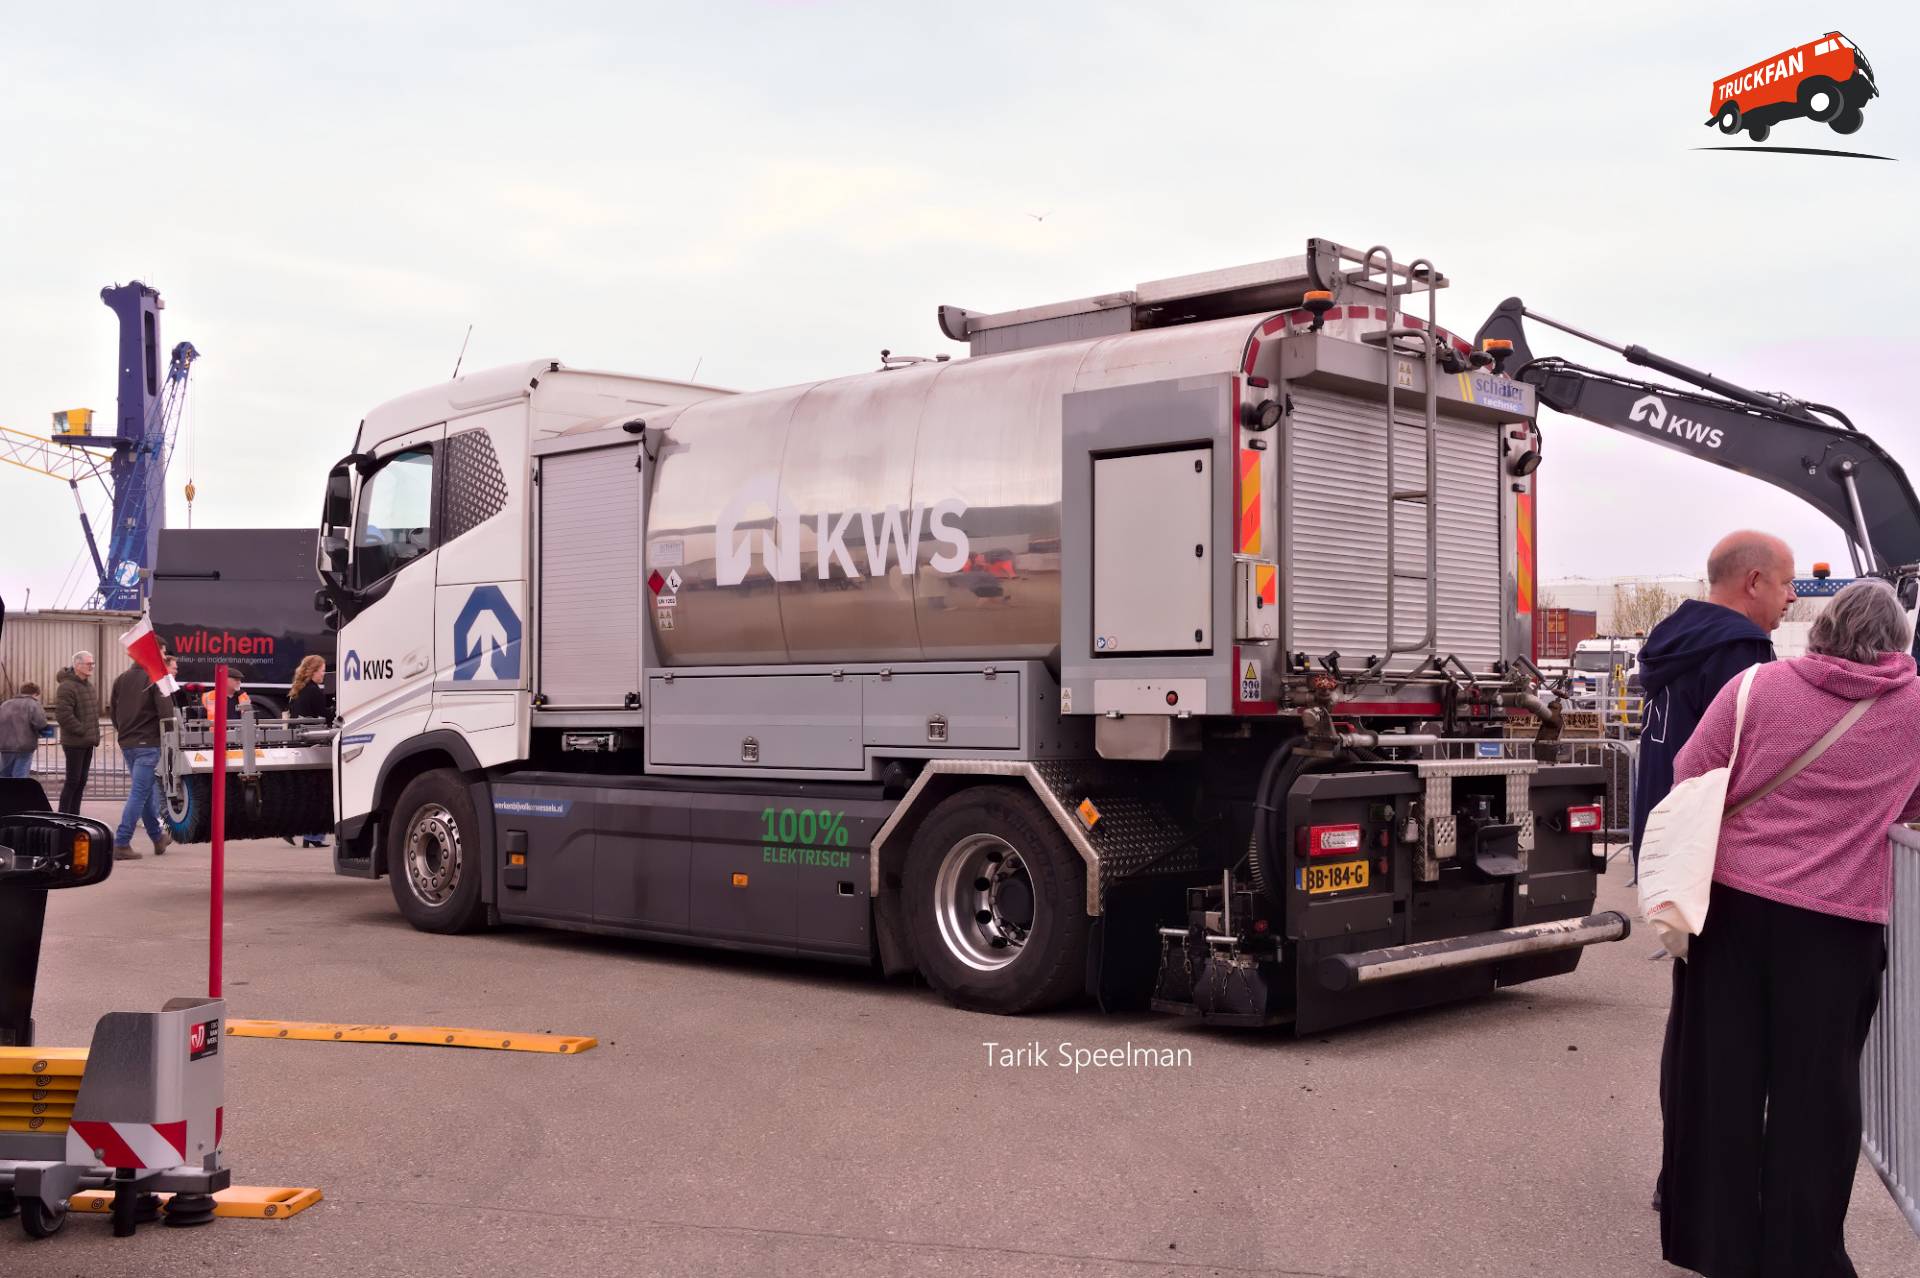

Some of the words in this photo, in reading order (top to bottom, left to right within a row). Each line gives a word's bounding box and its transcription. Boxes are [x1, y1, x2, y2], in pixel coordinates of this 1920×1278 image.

[1666, 415, 1724, 448] KWS
[817, 498, 970, 580] KWS
[175, 630, 274, 655] wilchem
[363, 658, 394, 681] KWS
[761, 808, 849, 847] 100%
[763, 847, 851, 868] ELEKTRISCH
[1307, 864, 1363, 890] BB-184-G
